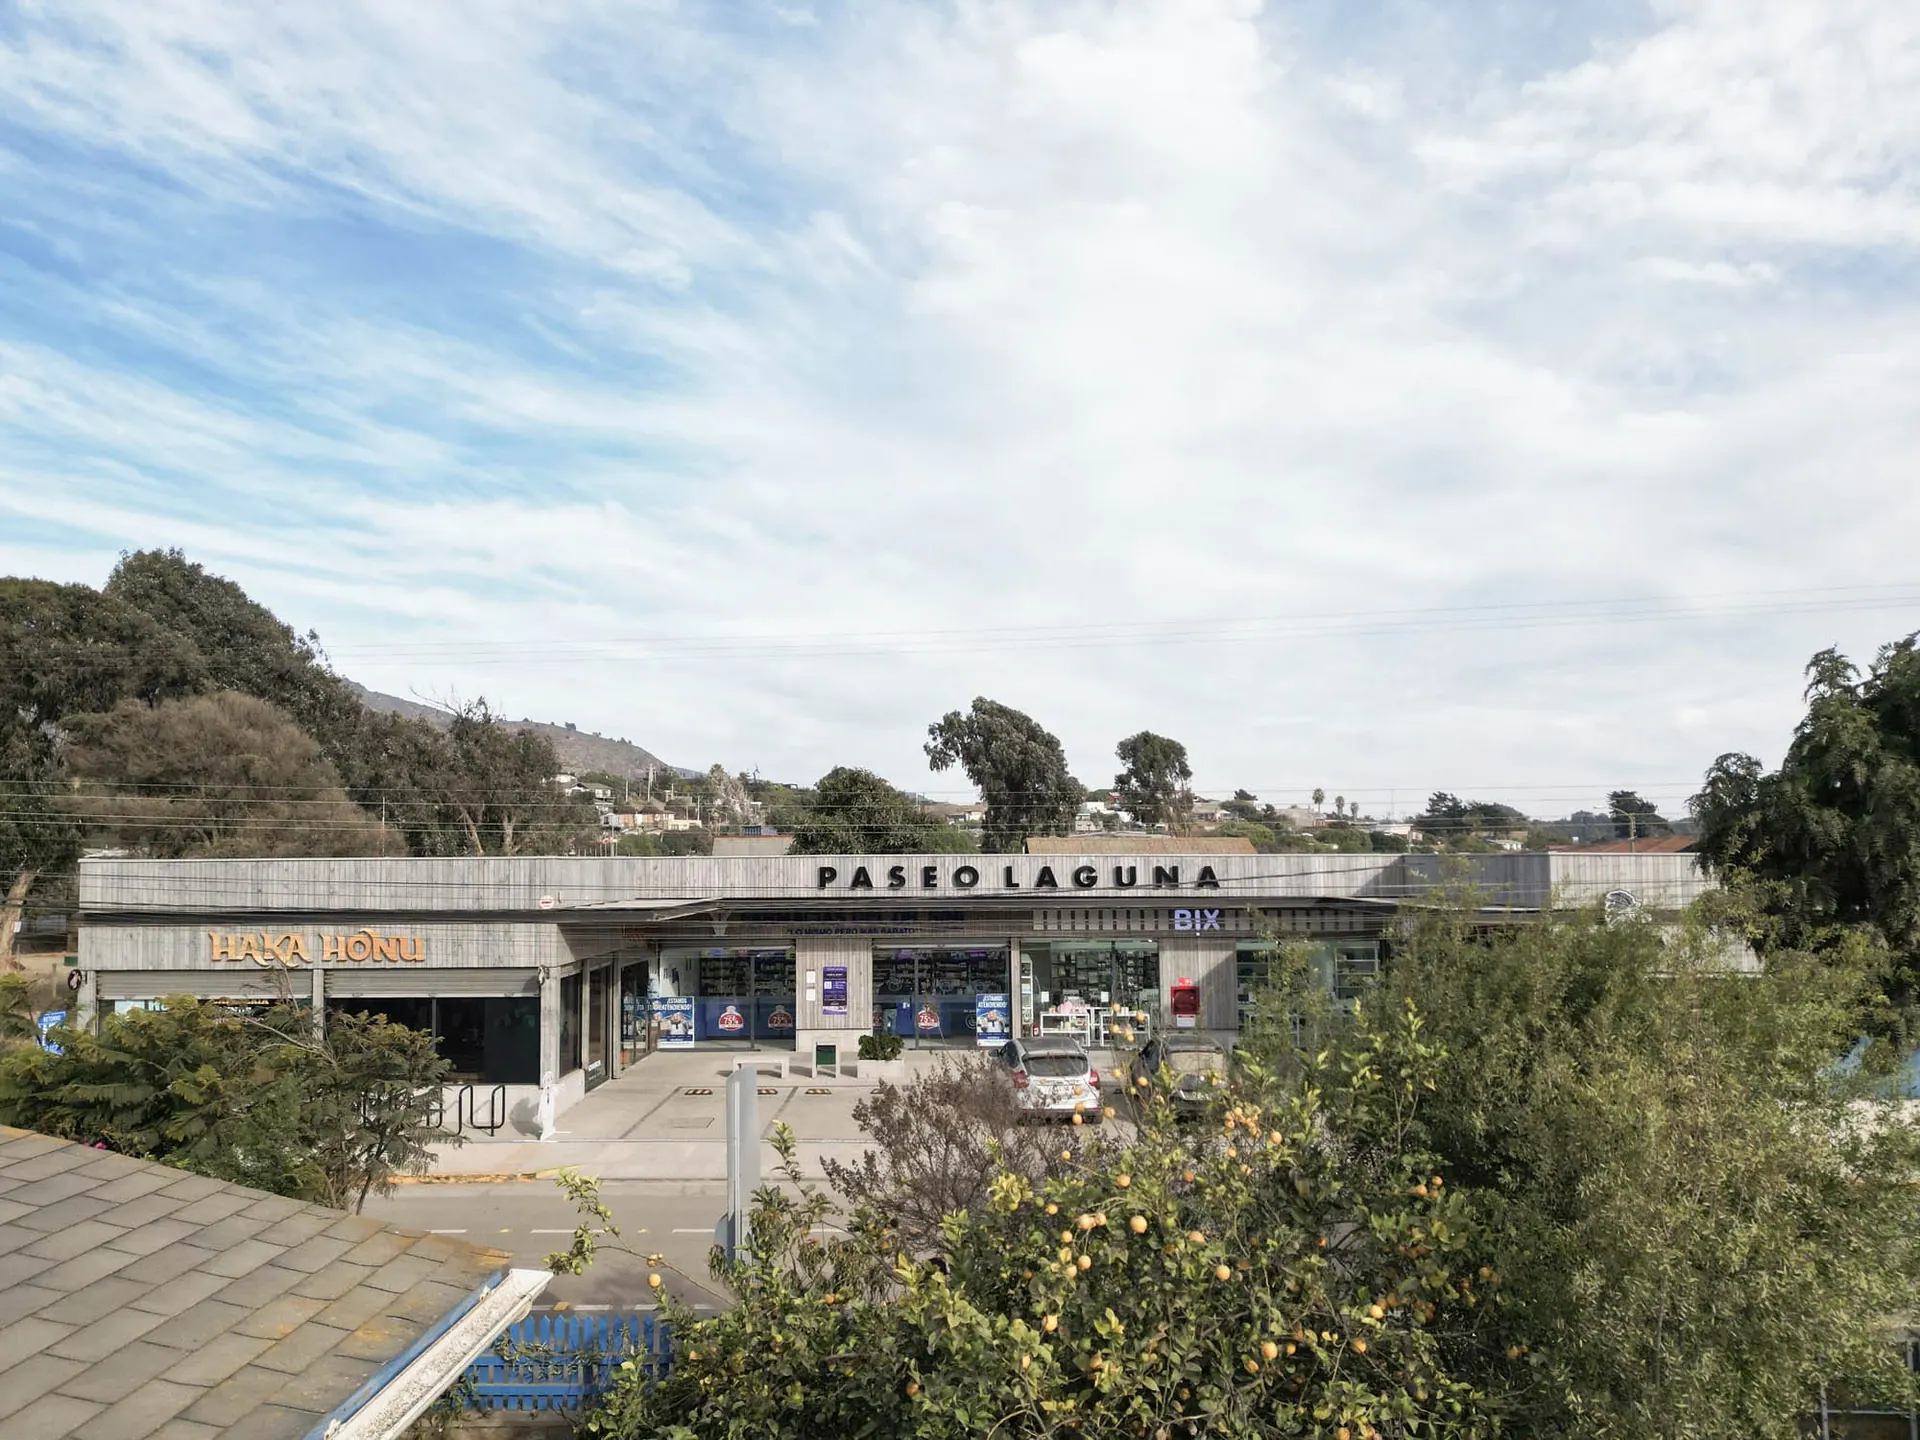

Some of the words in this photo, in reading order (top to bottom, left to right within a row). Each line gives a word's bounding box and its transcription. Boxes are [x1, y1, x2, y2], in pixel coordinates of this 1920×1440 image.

[817, 865, 980, 890] PASEO
[1003, 865, 1221, 890] LAGUNA
[1173, 909, 1221, 932] BIX
[208, 931, 313, 968] HAKA
[318, 928, 425, 962] HONU
